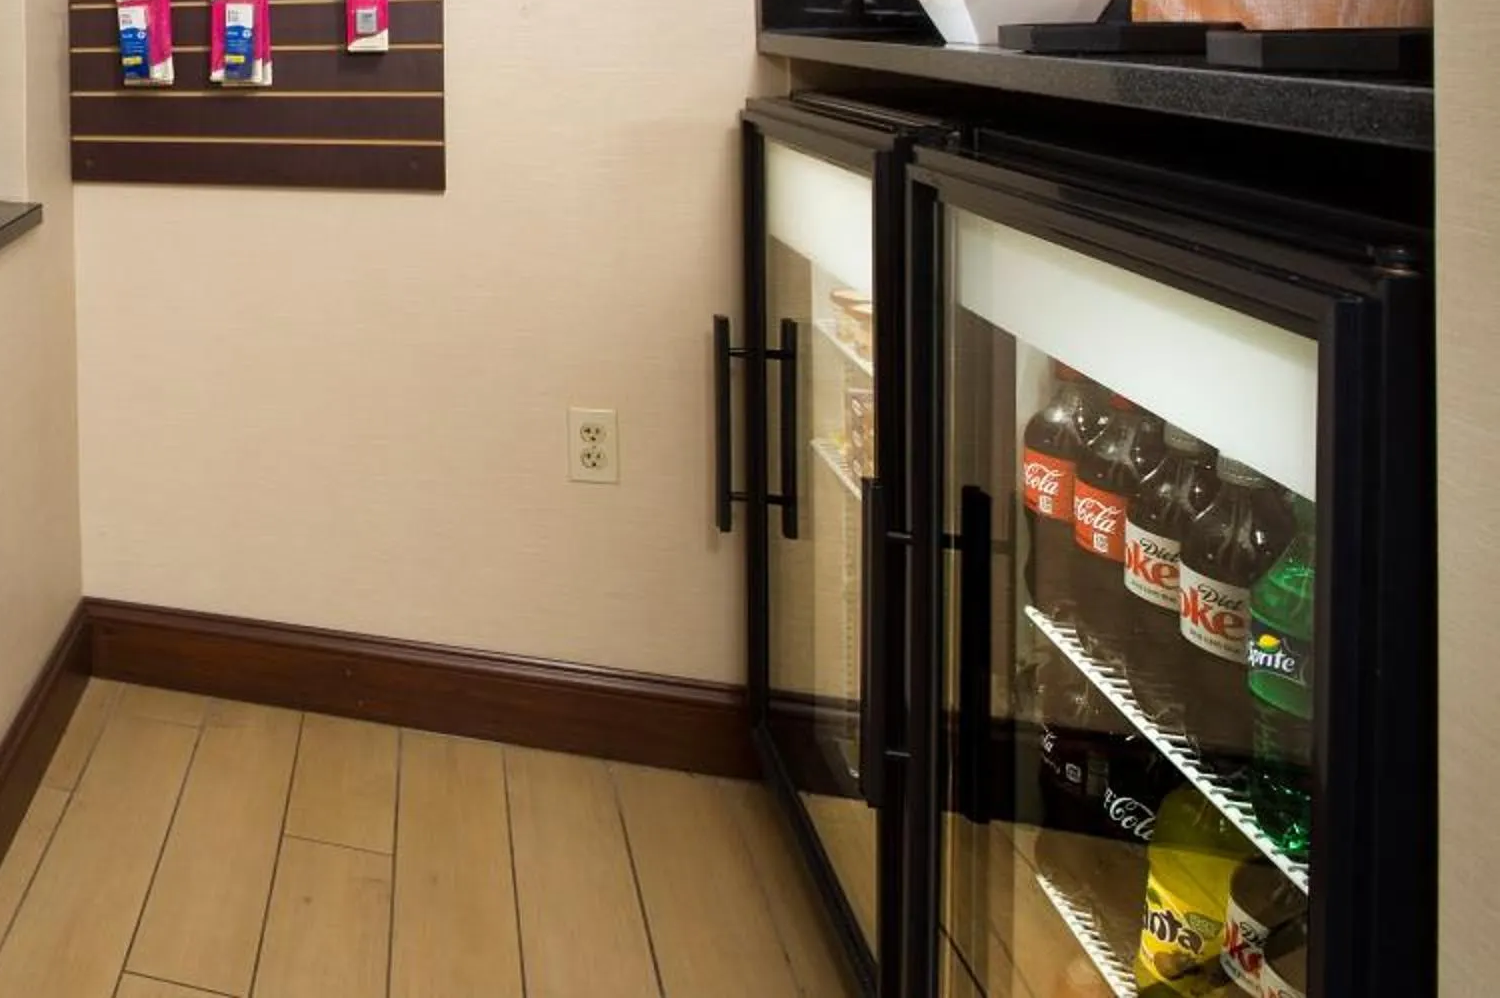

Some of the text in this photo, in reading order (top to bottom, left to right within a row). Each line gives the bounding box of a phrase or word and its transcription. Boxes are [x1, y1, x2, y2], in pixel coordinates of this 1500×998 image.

[1140, 537, 1181, 564] Diet
[1197, 583, 1243, 610] Diet
[1248, 641, 1296, 673] prite
